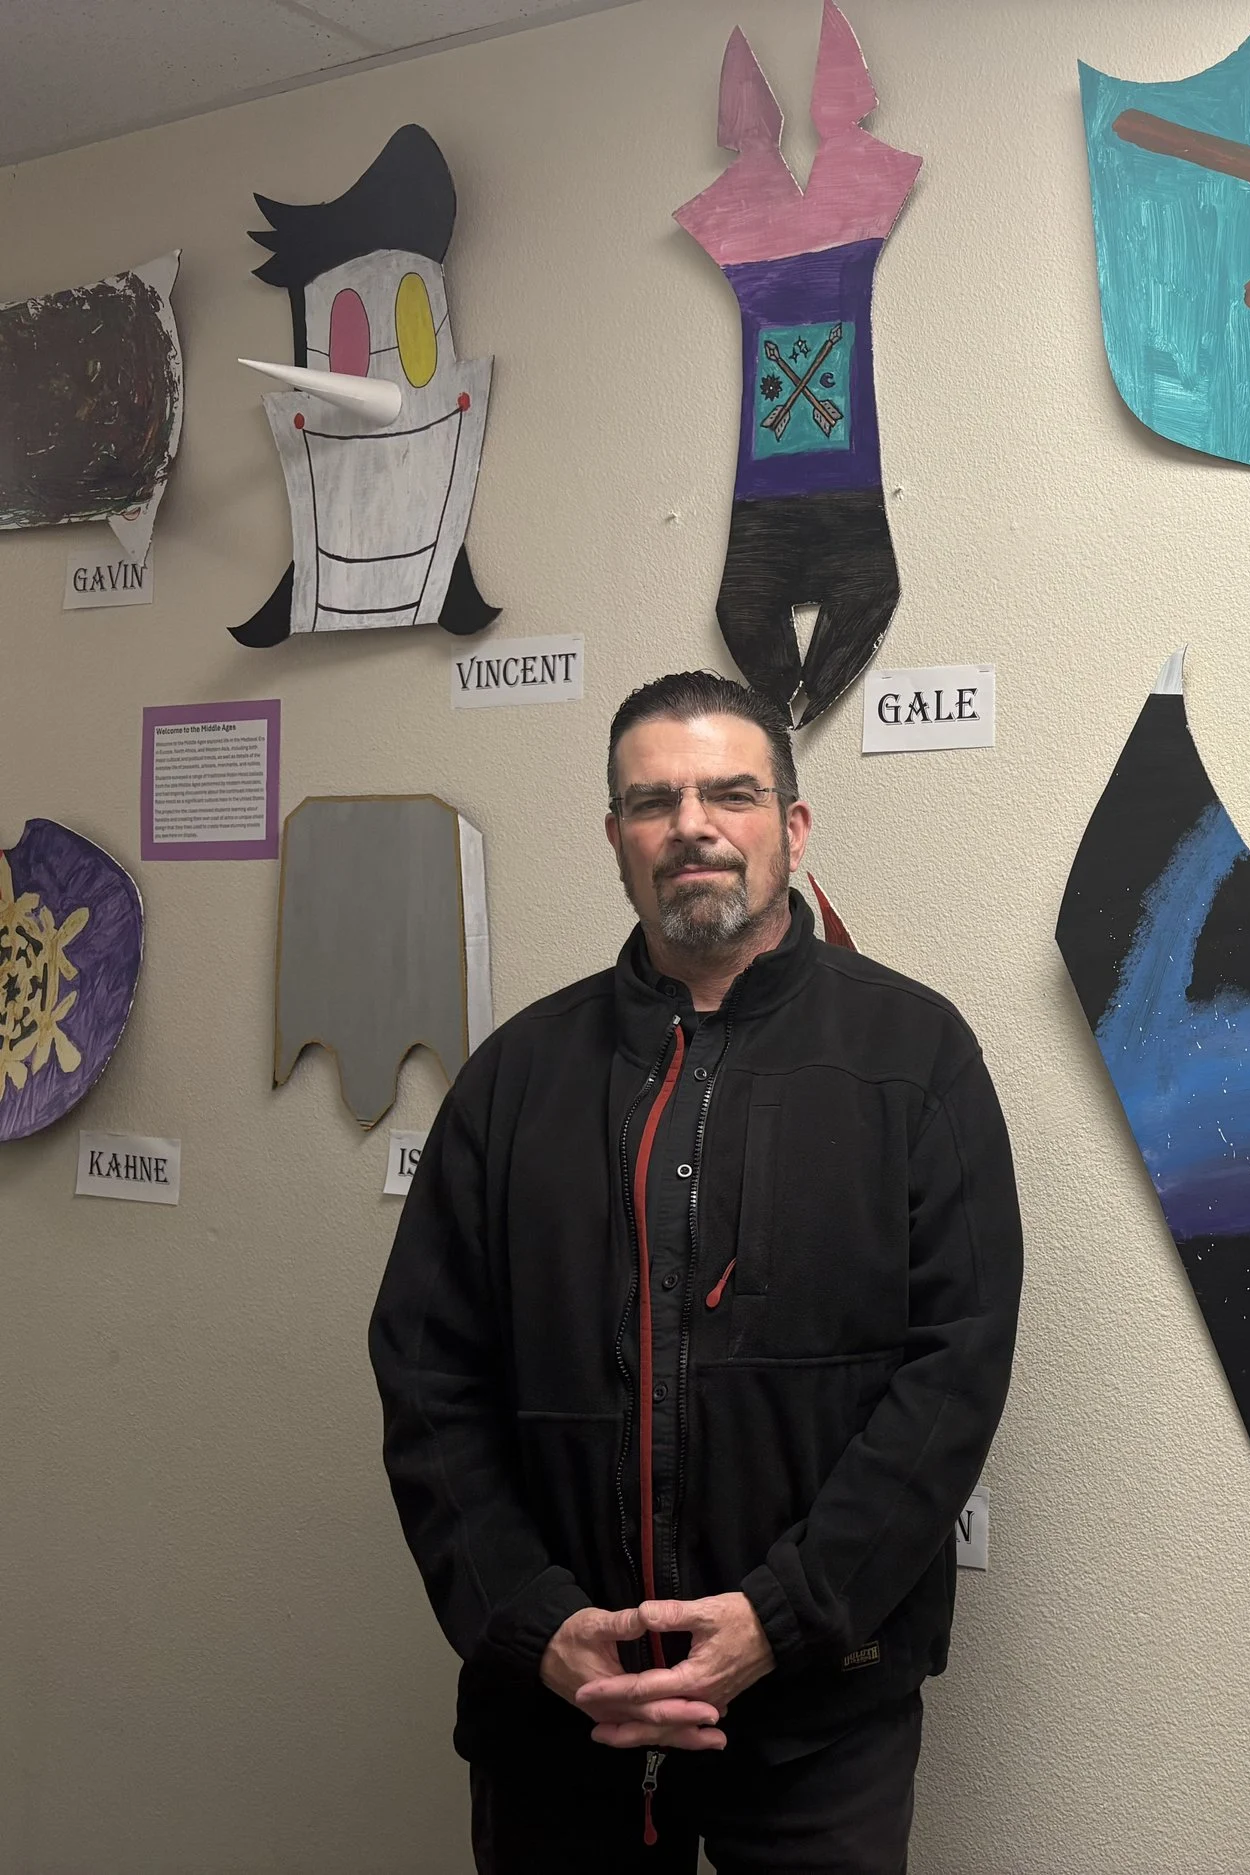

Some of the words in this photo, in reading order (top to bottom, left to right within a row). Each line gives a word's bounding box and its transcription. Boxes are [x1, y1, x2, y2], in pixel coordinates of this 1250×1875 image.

[73, 560, 147, 593] GAVIN
[456, 653, 577, 691] VINCENT
[878, 688, 980, 726] GALE
[156, 727, 183, 735] Welcome
[201, 724, 221, 732] Middle
[221, 724, 236, 732] Ages
[88, 1150, 170, 1185] KAHNE
